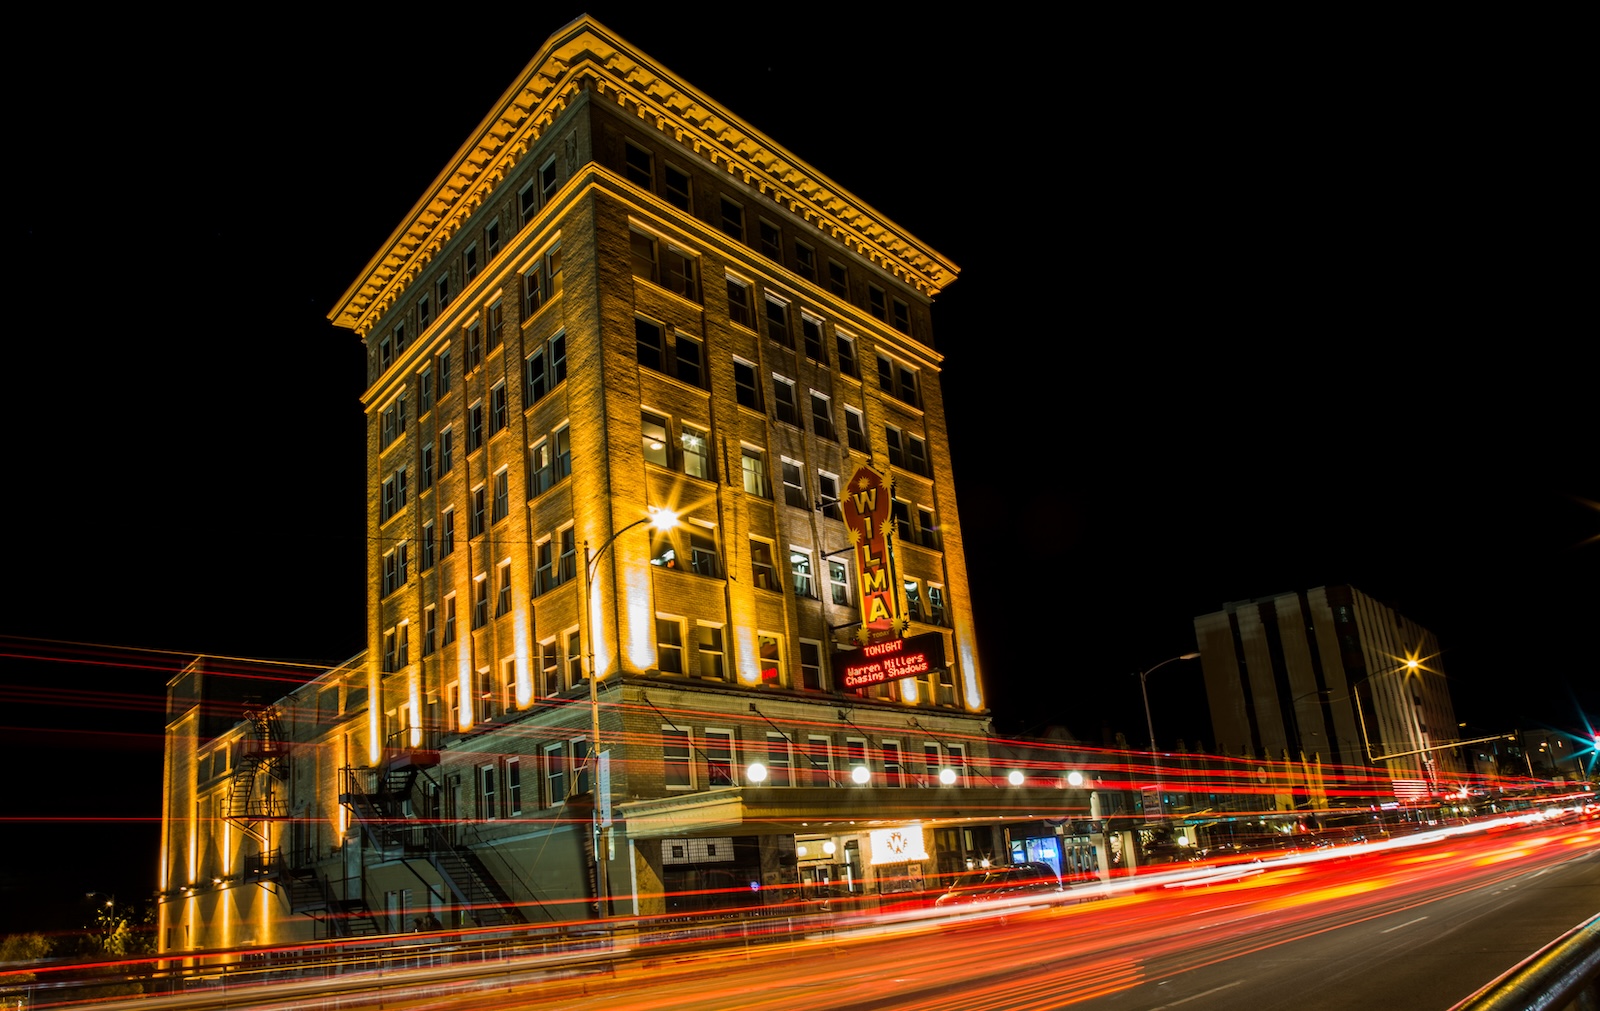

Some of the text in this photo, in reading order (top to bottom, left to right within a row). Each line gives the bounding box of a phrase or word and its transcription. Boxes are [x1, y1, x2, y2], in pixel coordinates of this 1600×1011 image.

[853, 487, 891, 623] WILMA
[864, 640, 903, 657] TONIGHT
[845, 662, 928, 686] Chasing Shadows
[847, 654, 924, 677] Warren Millers
